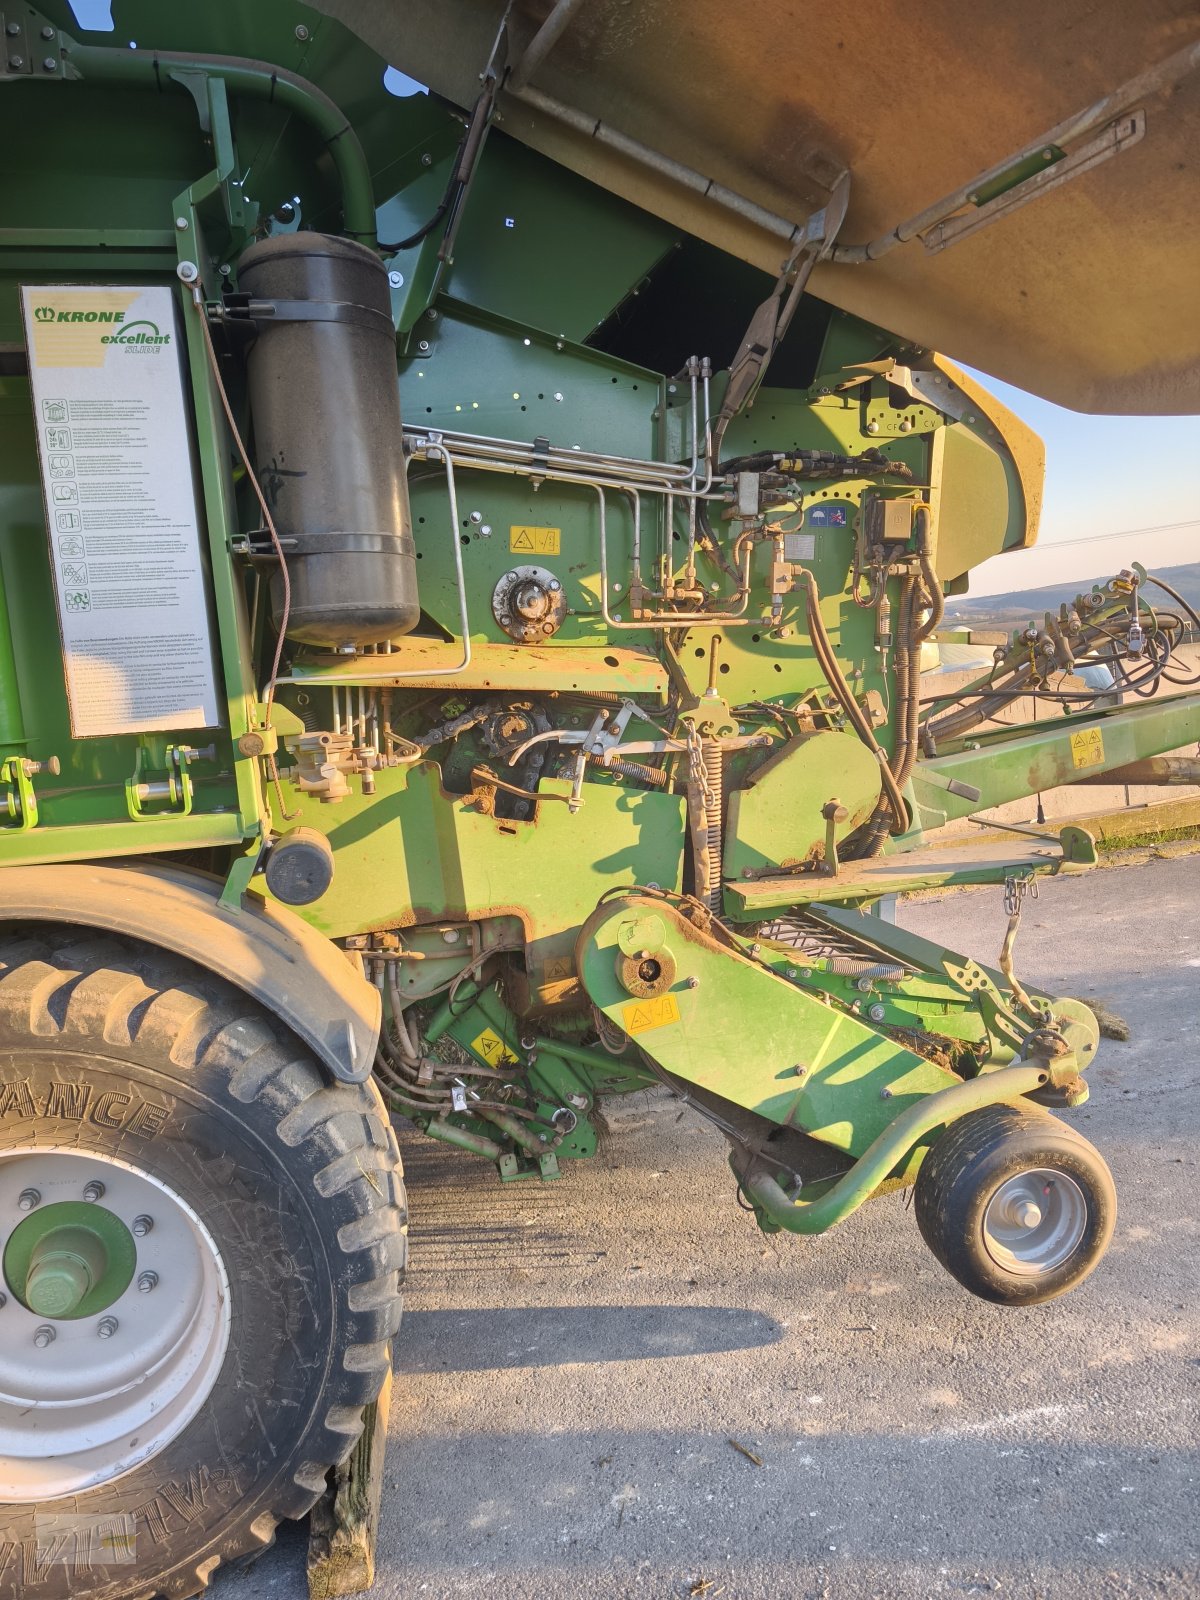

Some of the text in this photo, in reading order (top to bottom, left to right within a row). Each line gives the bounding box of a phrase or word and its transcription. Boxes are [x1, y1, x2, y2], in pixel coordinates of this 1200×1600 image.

[57, 311, 125, 323] KRONE
[100, 333, 171, 345] excellent
[124, 345, 161, 354] SLIDE
